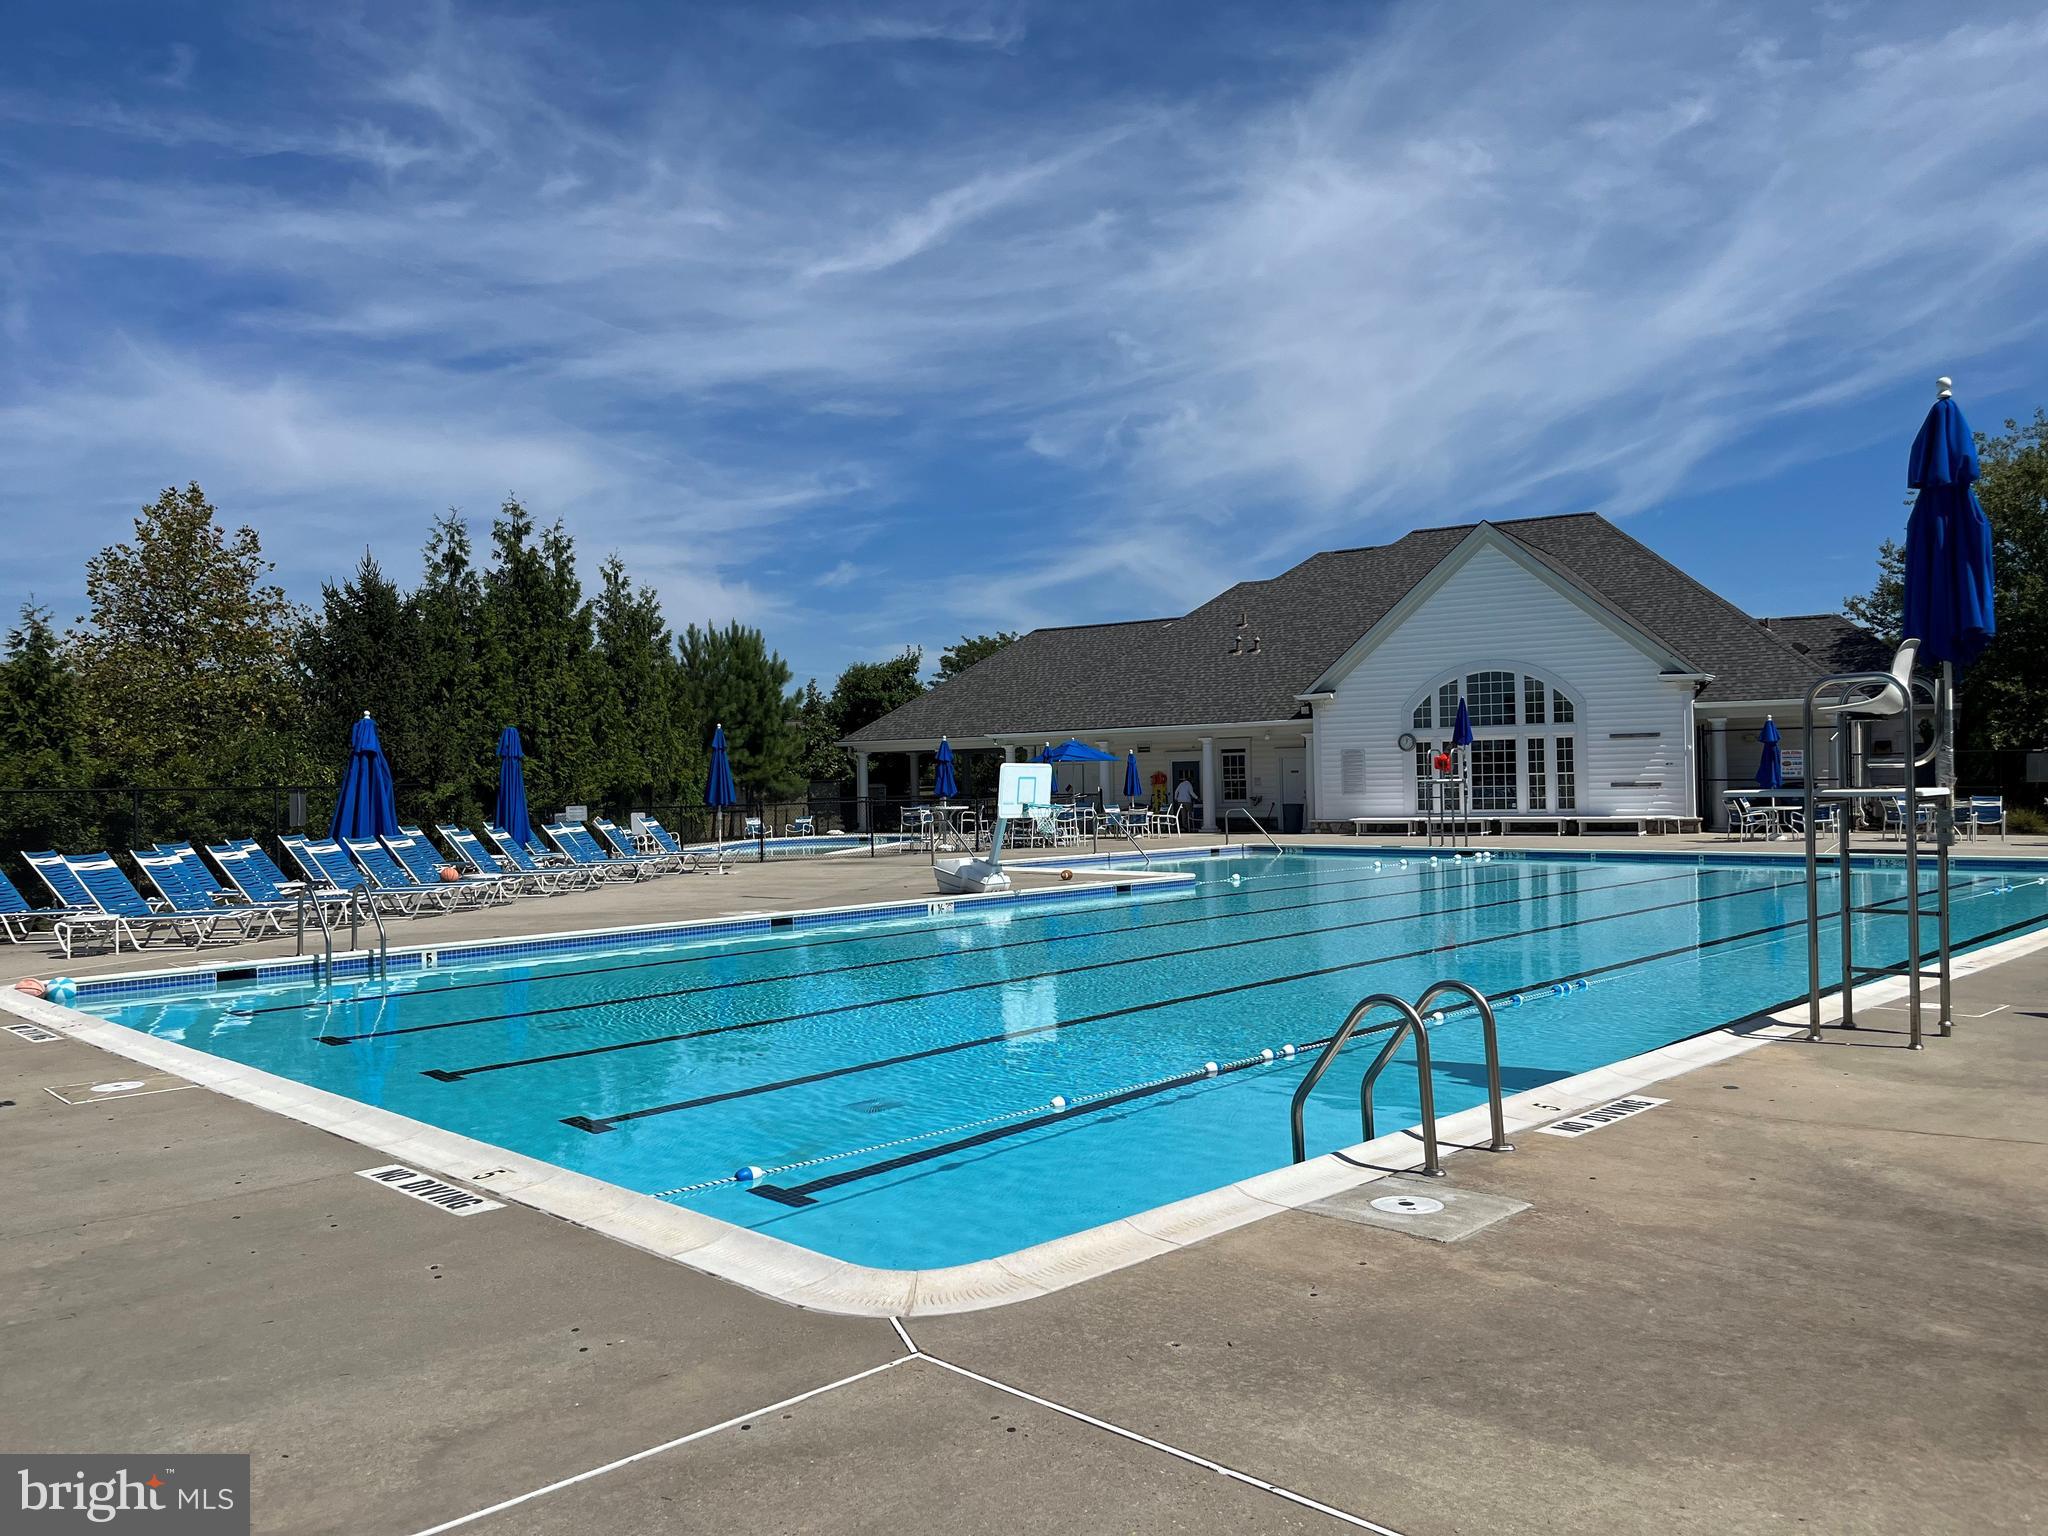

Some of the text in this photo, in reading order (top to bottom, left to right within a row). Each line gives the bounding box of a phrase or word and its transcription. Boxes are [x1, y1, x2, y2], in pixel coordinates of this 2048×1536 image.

[1550, 1099, 1656, 1133] NO DIVING
[370, 1168, 484, 1210] NO DIVING
[472, 1169, 507, 1180] 5
